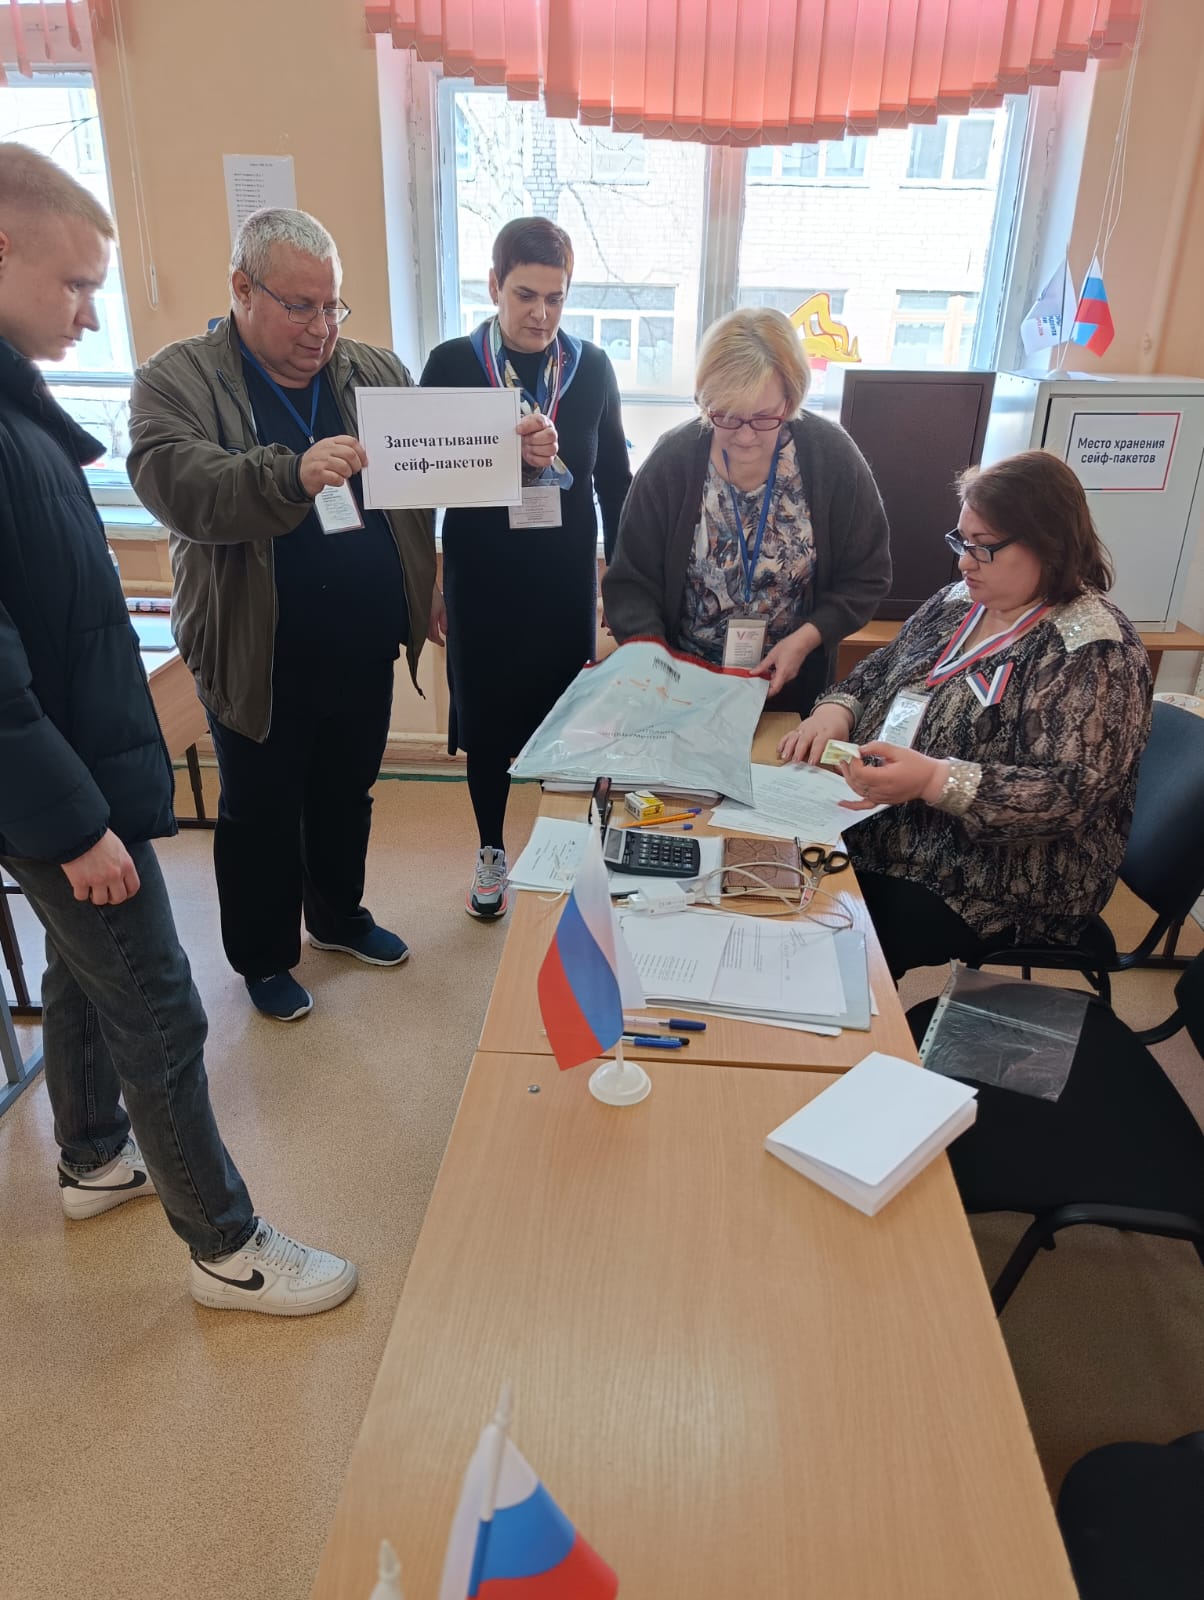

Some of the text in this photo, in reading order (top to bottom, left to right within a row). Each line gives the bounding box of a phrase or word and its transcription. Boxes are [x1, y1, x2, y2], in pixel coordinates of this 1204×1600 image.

[384, 435, 499, 449] Запечатывание
[1077, 437, 1165, 451] Место хранения
[1081, 451, 1156, 465] сейф-пакетов
[394, 457, 493, 474] сейф-пакетов
